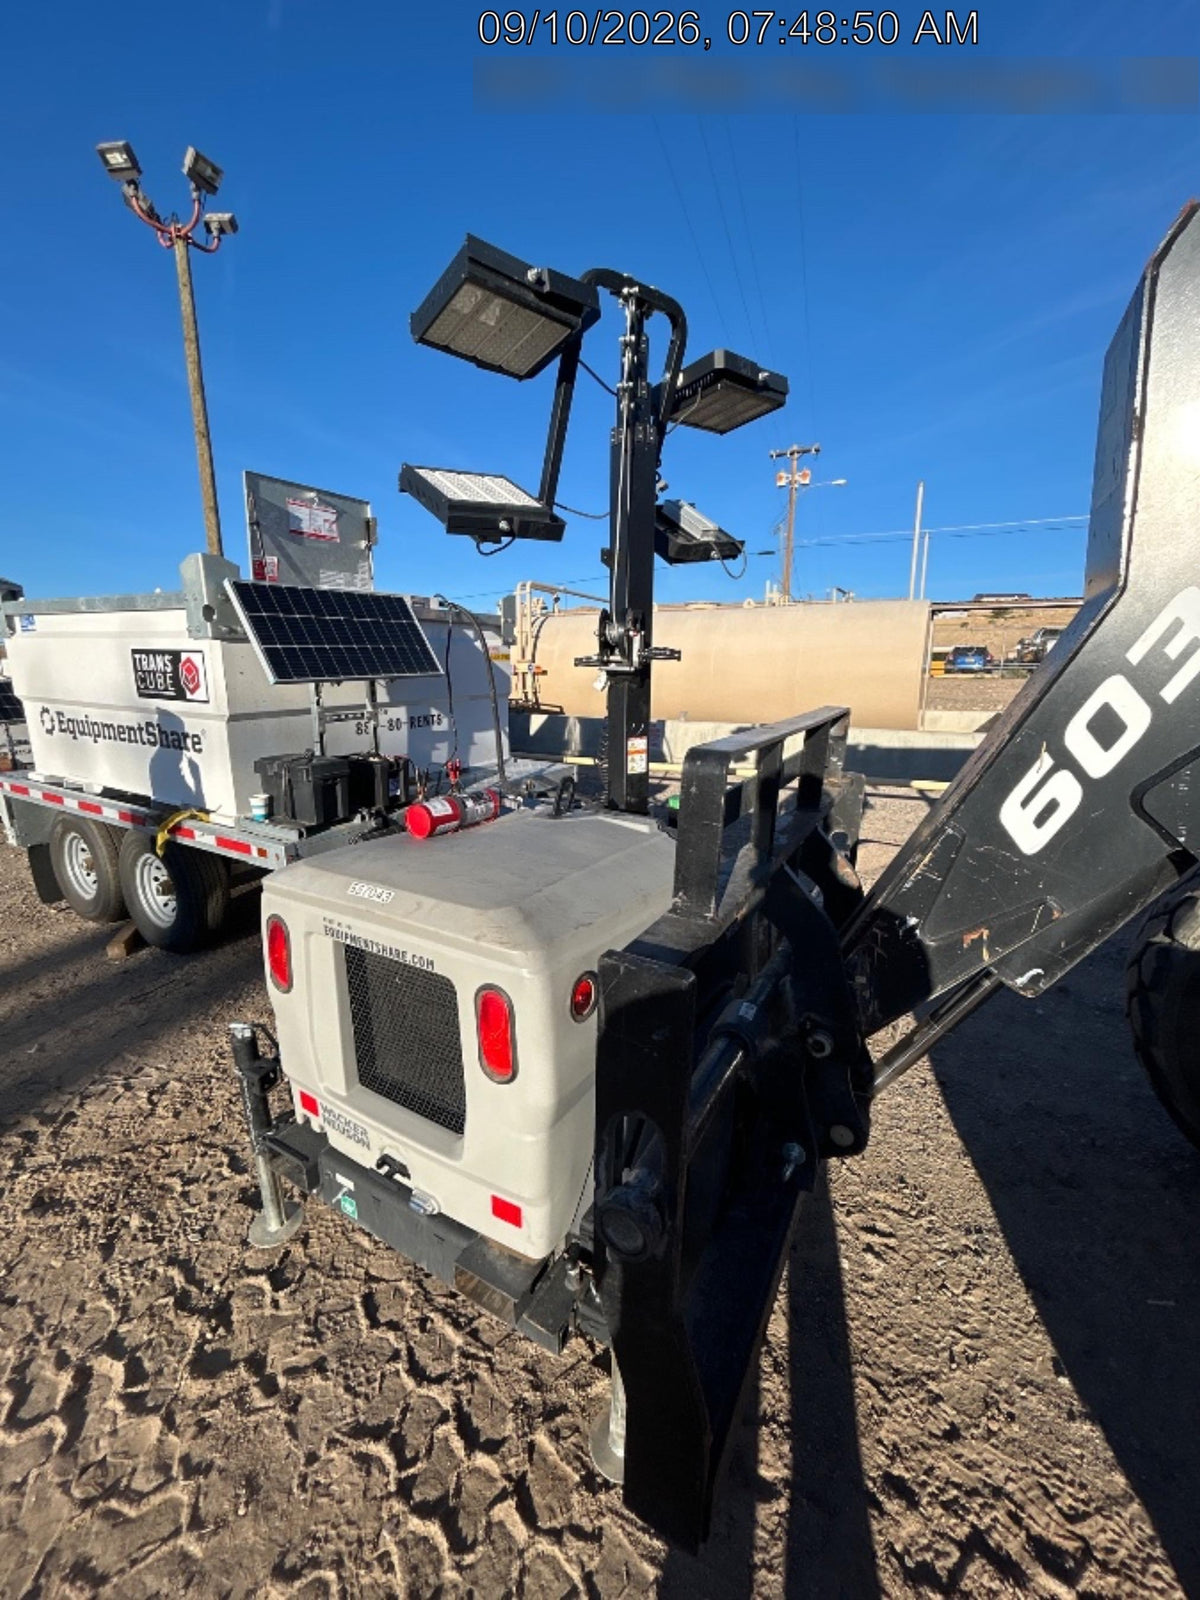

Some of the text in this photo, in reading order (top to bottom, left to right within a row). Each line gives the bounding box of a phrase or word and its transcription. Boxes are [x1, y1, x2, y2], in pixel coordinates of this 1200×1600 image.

[133, 653, 173, 673] TRANS
[135, 671, 176, 691] CUBE
[55, 710, 204, 753] EquipmentShare
[999, 585, 1200, 855] 603
[324, 925, 435, 971] EQUIPMENTSHARE.COM
